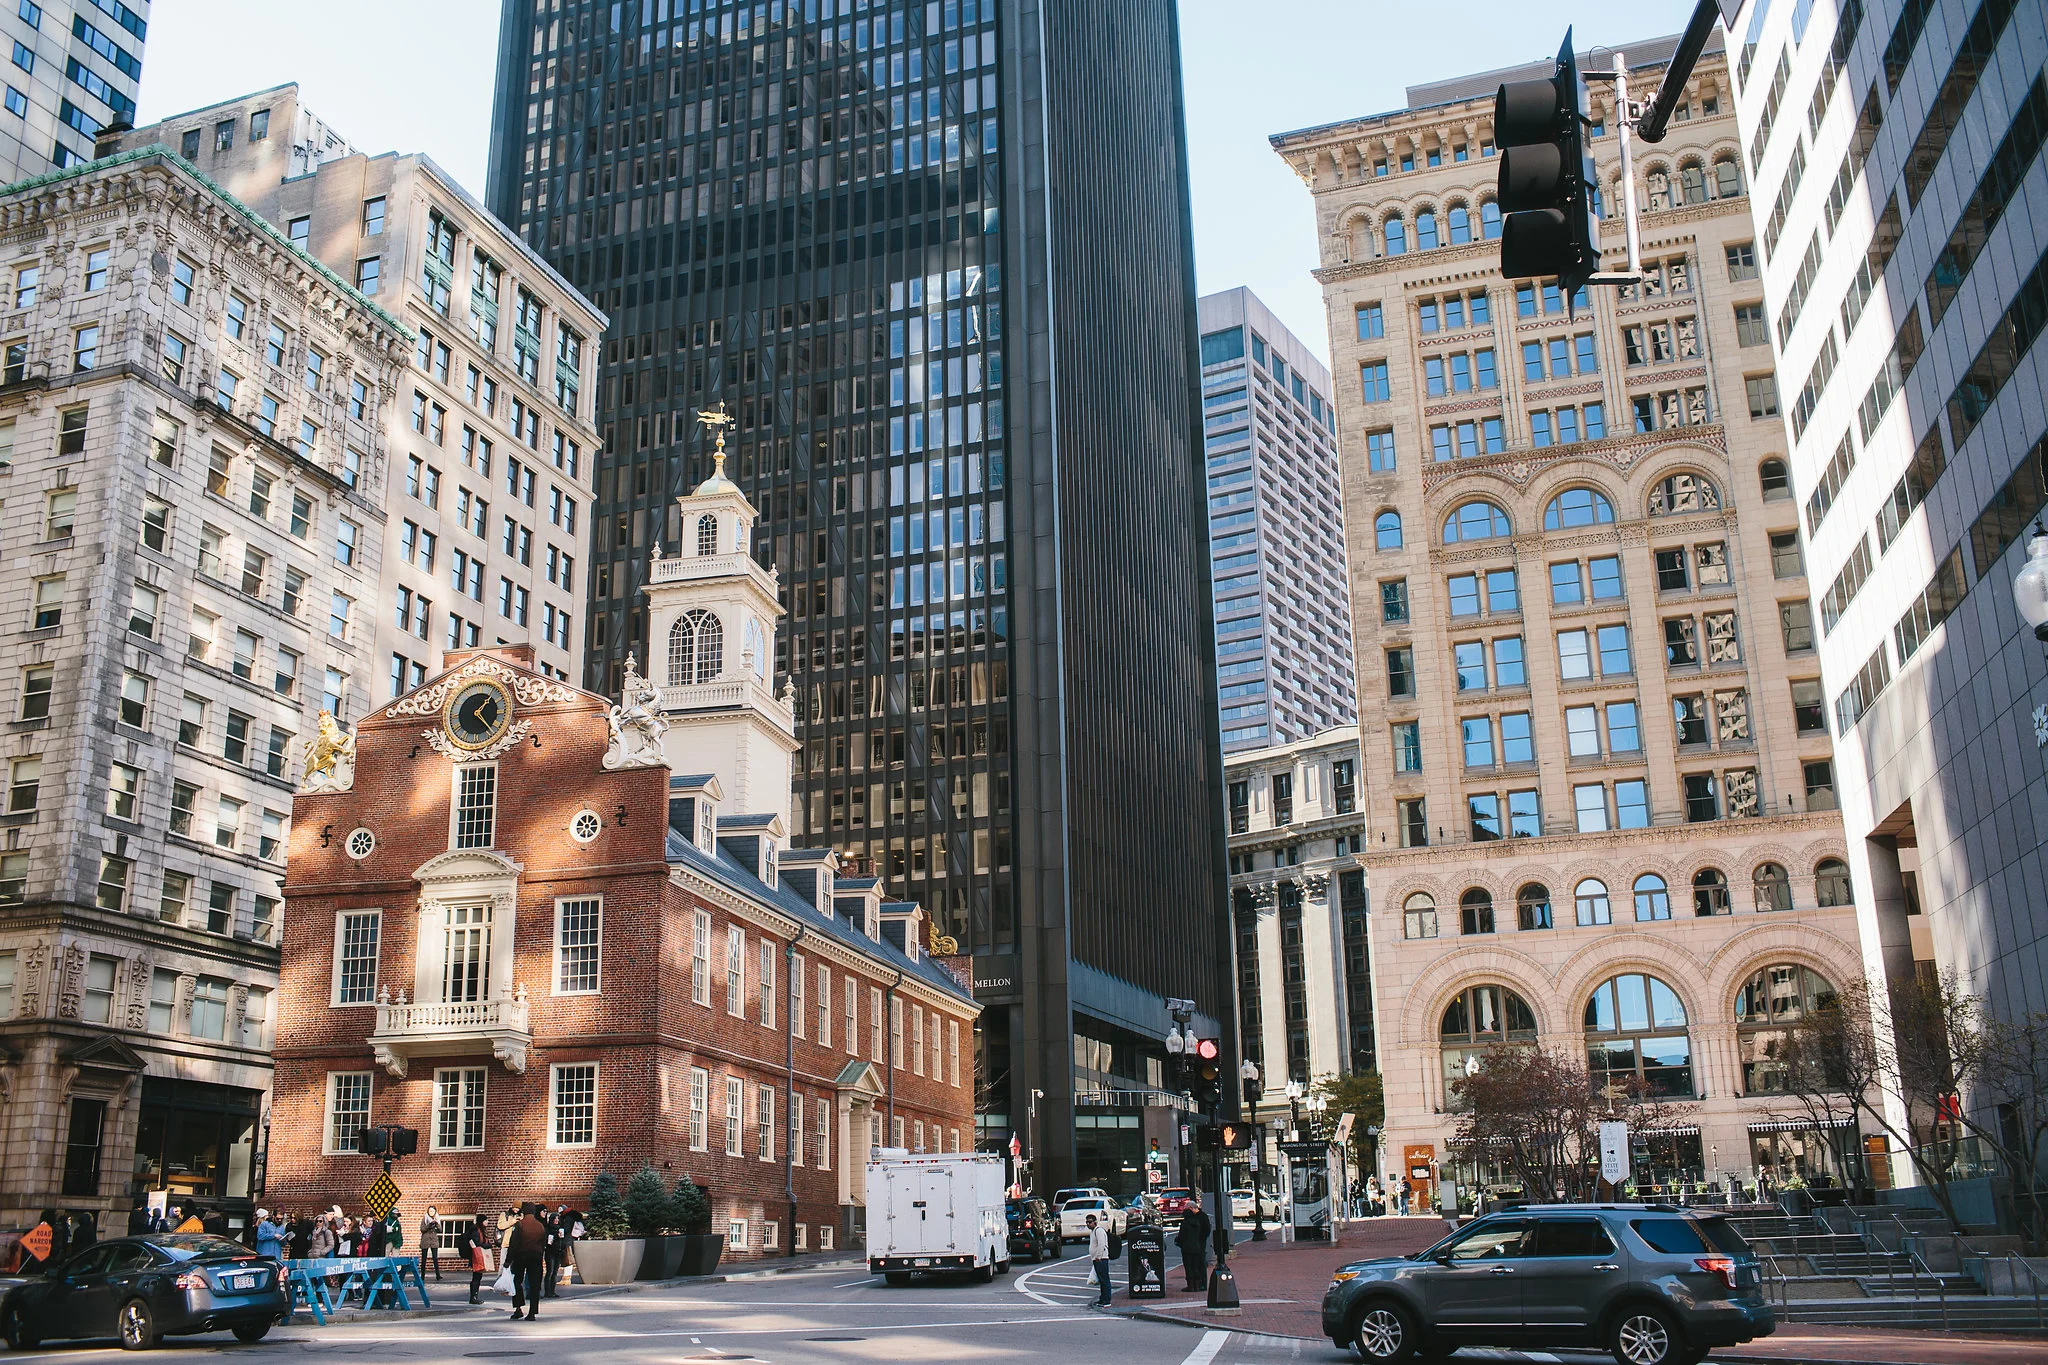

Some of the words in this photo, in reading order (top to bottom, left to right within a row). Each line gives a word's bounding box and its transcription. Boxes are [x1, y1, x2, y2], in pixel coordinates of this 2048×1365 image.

[974, 978, 1011, 988] MELLON
[325, 1265, 345, 1275] BOSTON
[352, 1261, 368, 1271] POLICE
